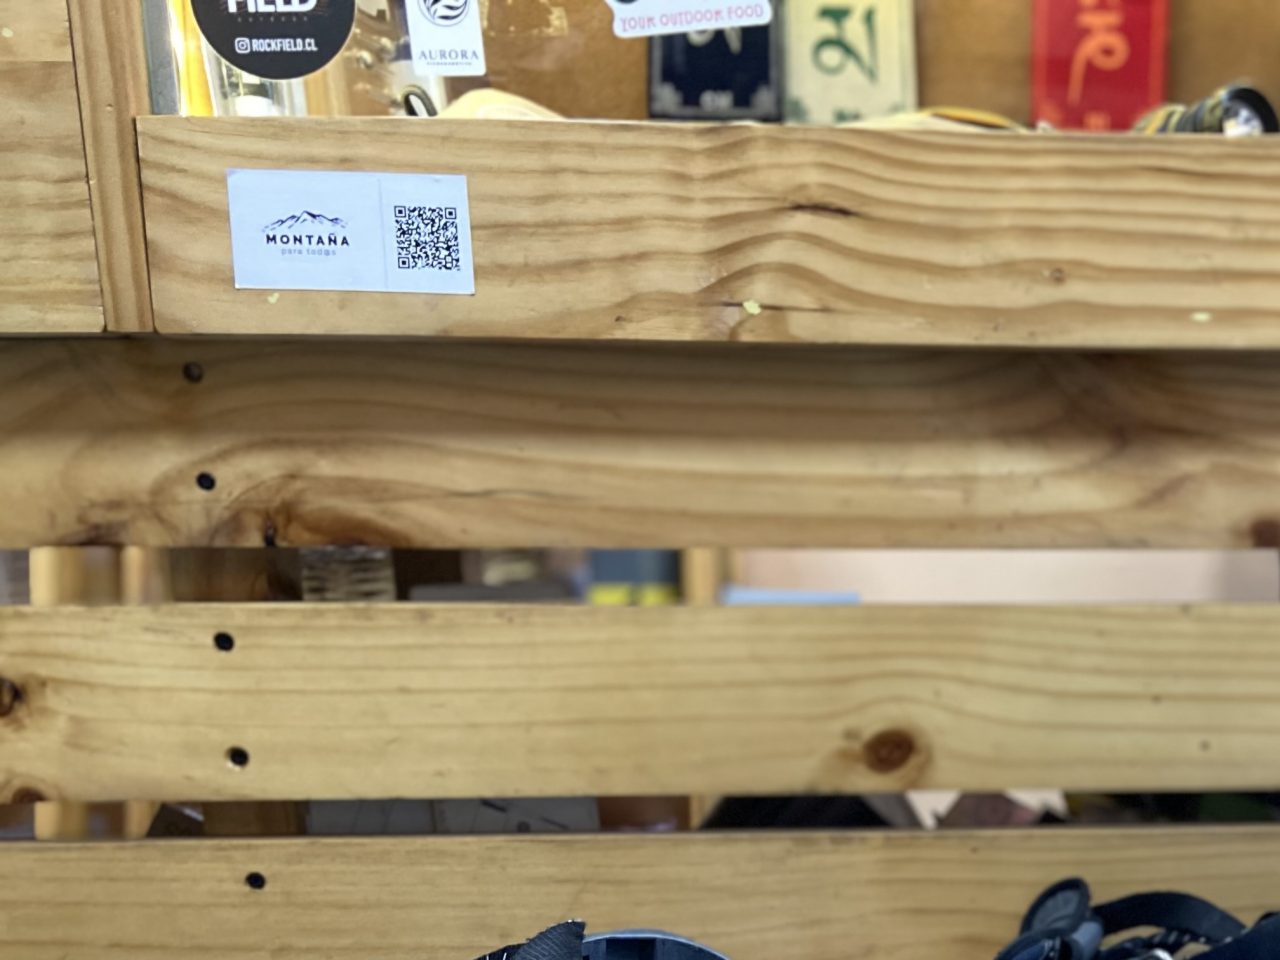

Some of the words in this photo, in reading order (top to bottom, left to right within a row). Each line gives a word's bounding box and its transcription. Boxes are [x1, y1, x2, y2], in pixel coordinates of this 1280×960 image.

[619, 16, 656, 32] YOUR
[659, 9, 725, 27] OUTDOOR
[728, 4, 764, 20] FOOD
[251, 38, 318, 52] ROCKFIELD.CL
[418, 49, 479, 61] AURORA
[266, 233, 349, 246] MONTAÑA
[281, 248, 303, 256] para
